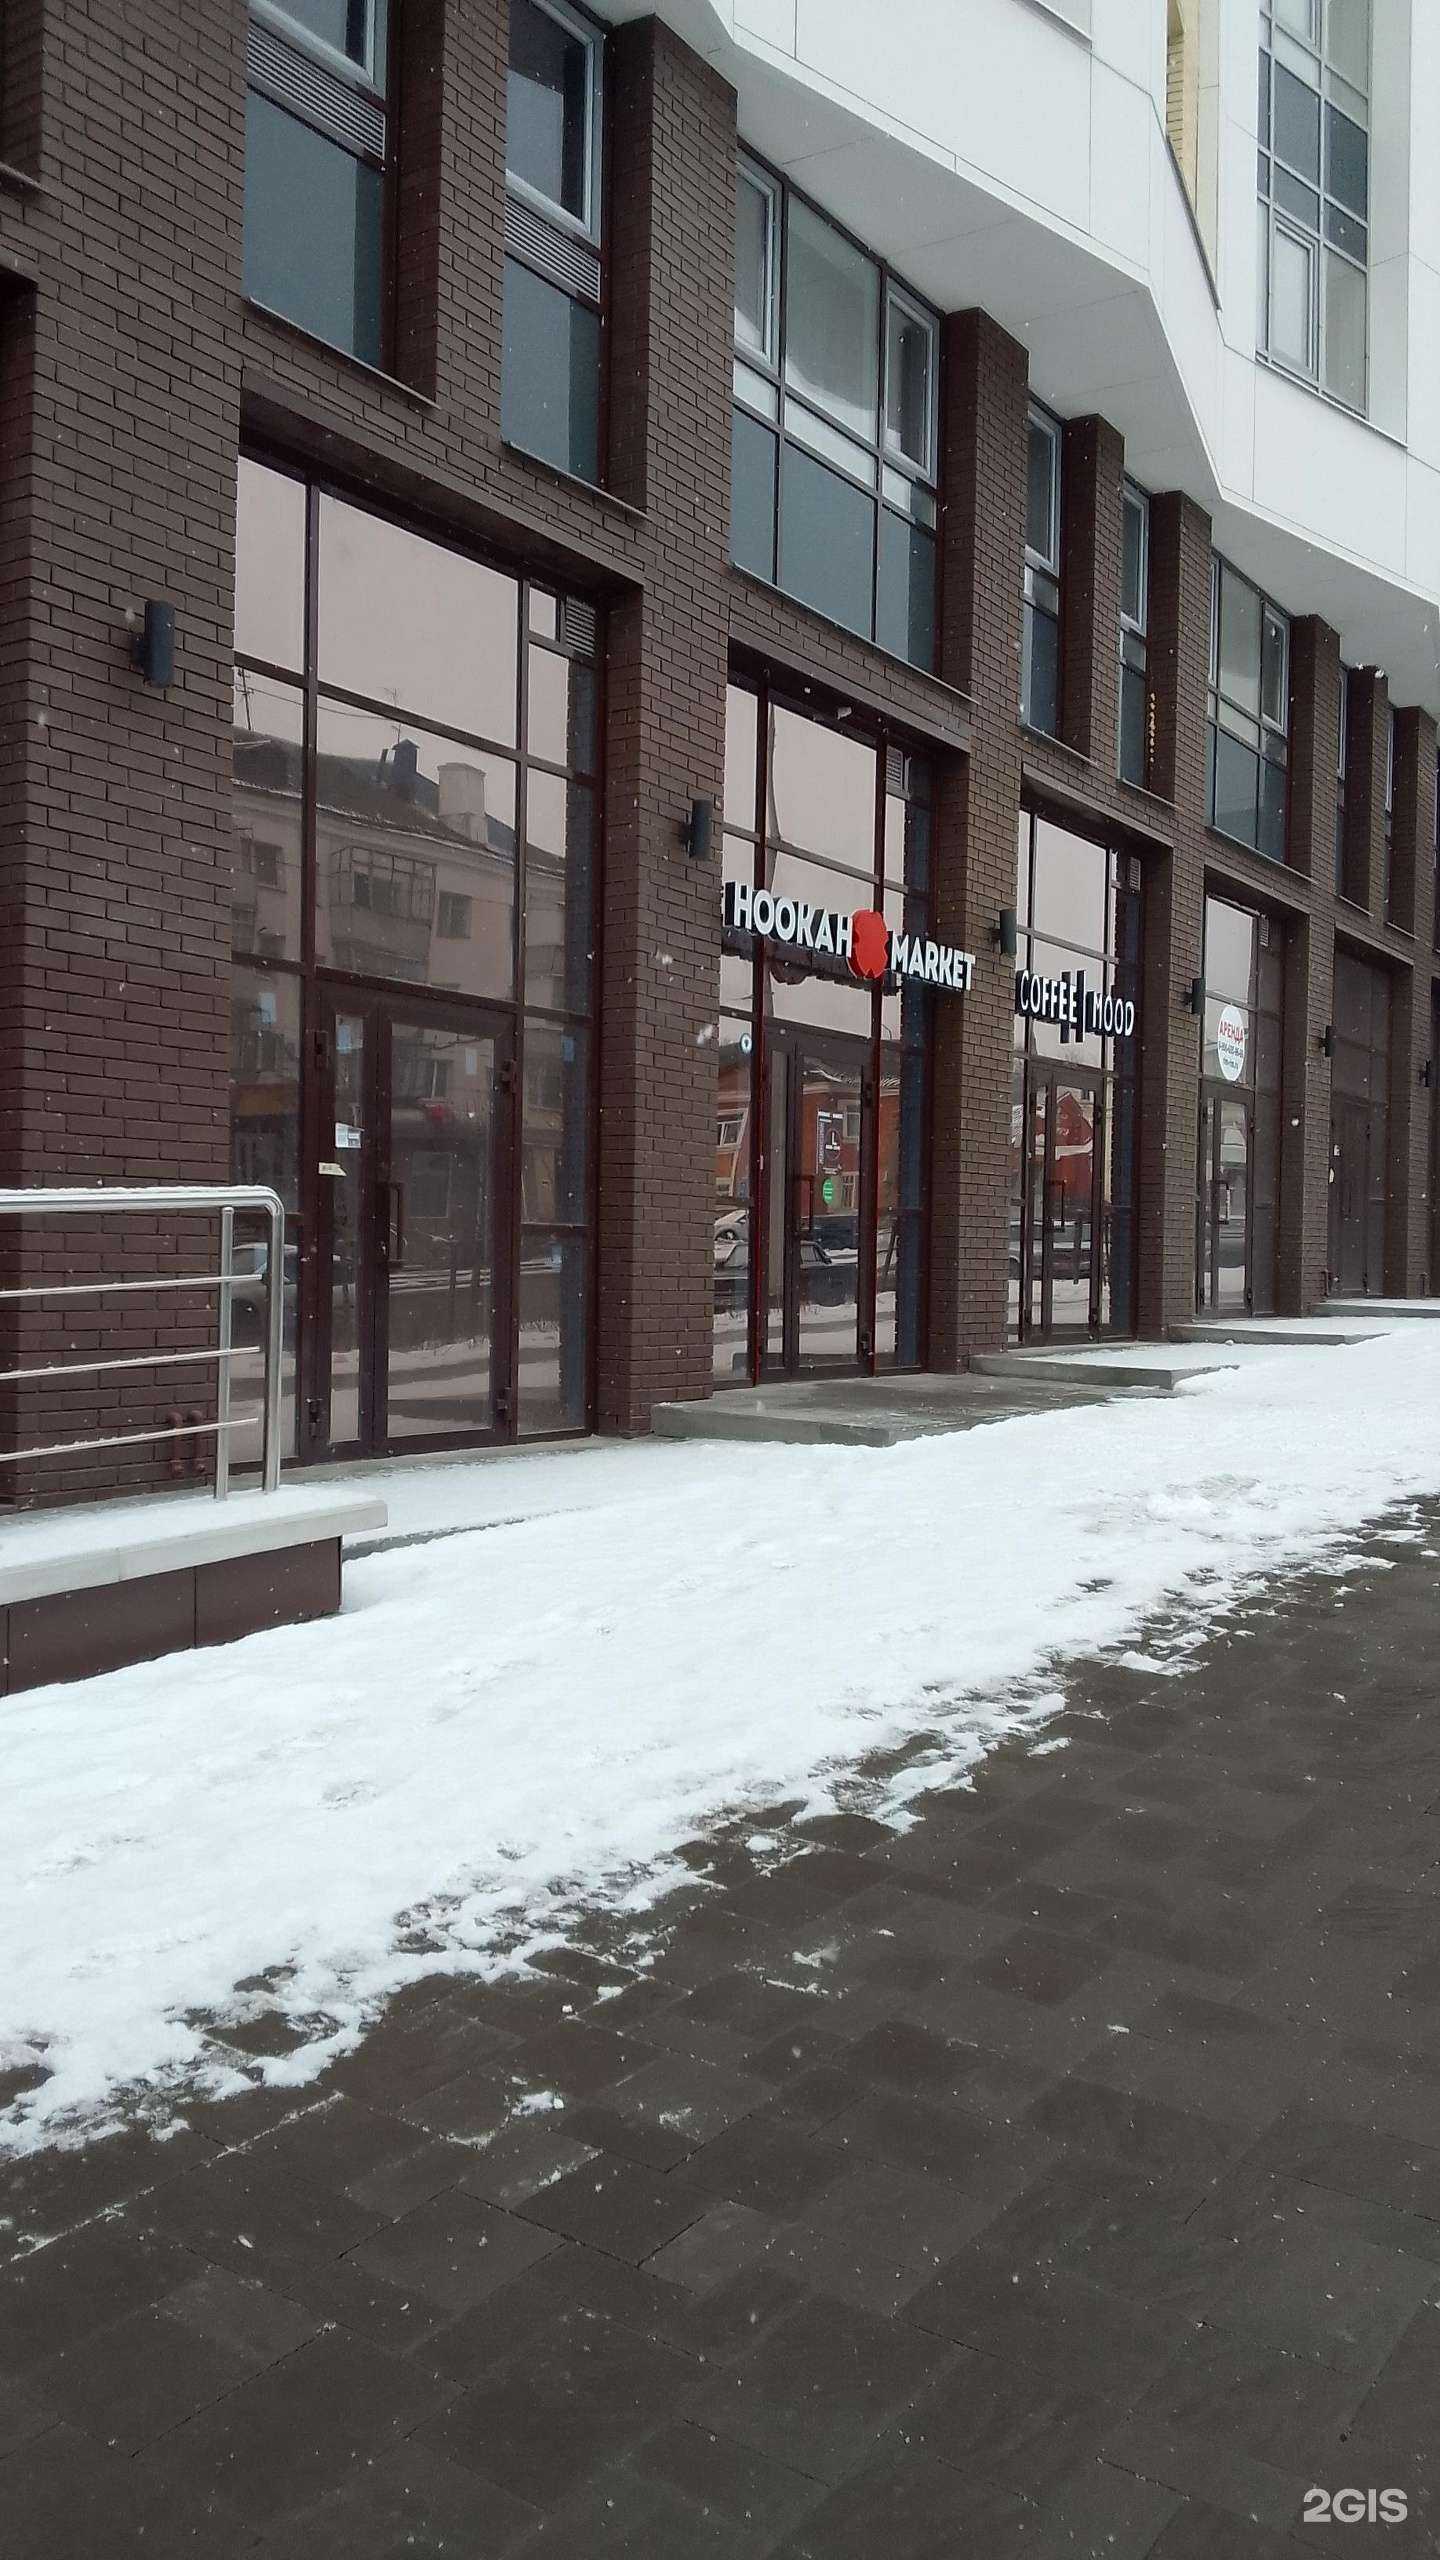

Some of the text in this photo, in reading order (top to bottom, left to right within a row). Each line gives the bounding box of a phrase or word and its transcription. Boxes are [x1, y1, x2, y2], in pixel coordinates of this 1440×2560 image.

[733, 881, 976, 991] HOOKAH MARKET
[1020, 969, 1135, 1036] COFFEE MOOD
[1219, 1020, 1244, 1043] АРЕНДА
